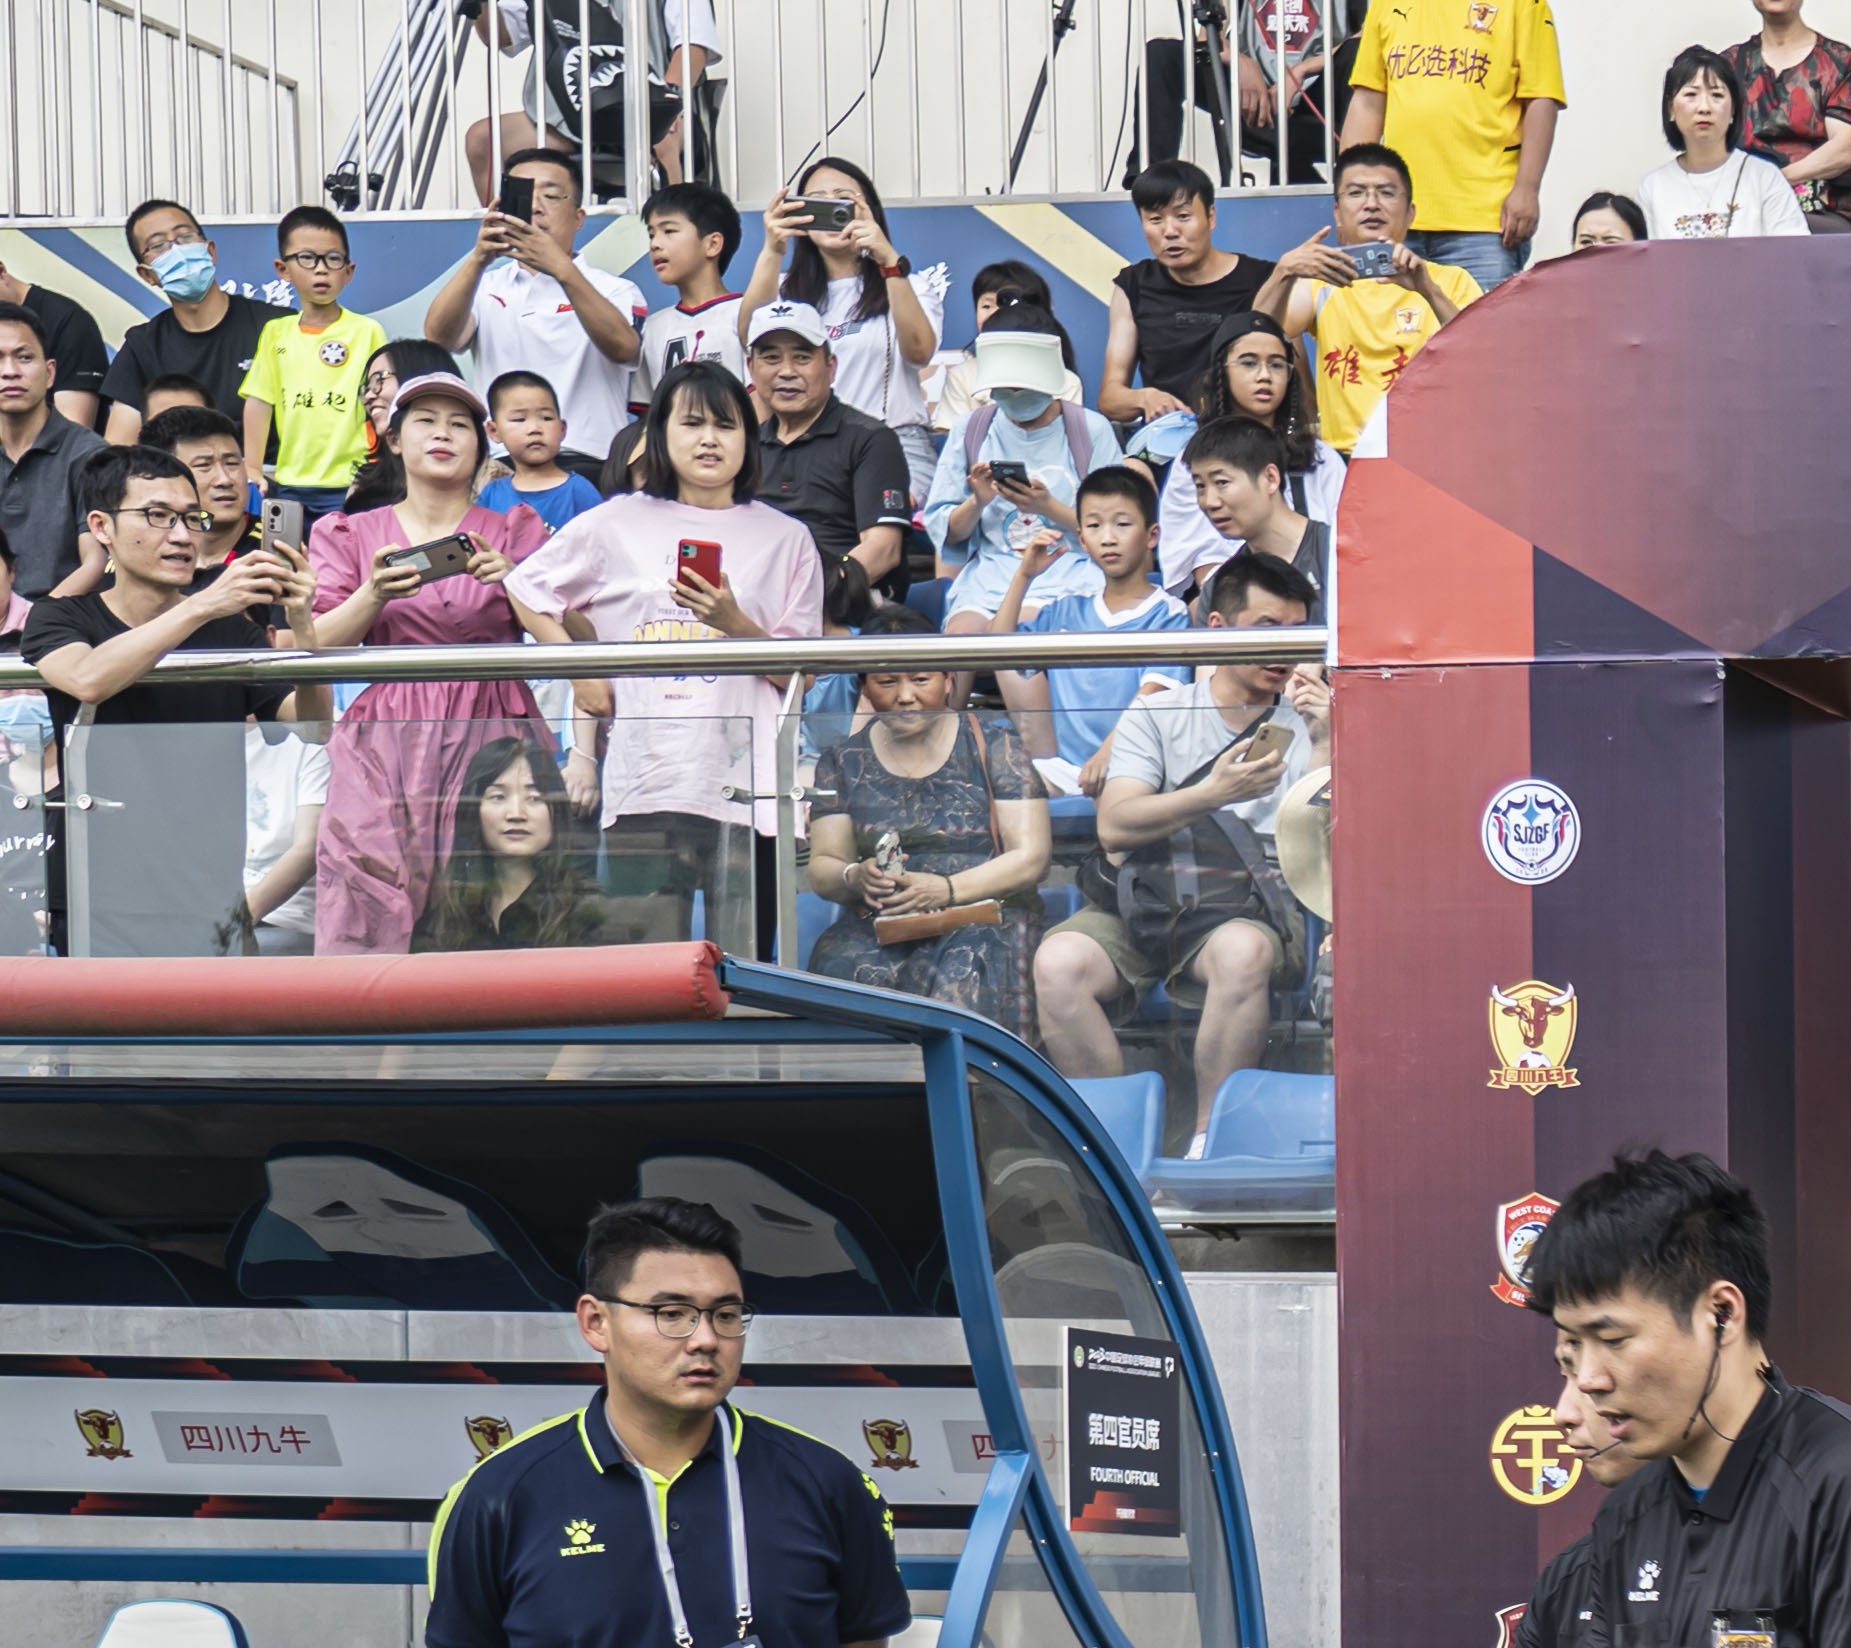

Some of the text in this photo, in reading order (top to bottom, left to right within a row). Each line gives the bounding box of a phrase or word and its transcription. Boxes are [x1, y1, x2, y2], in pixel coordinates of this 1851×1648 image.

[181, 1424, 312, 1455] 四川九牛
[1088, 1412, 1161, 1451] 第四官员席
[1090, 1466, 1160, 1487] FOURTH OFFICIAL
[560, 1544, 606, 1557] KELME
